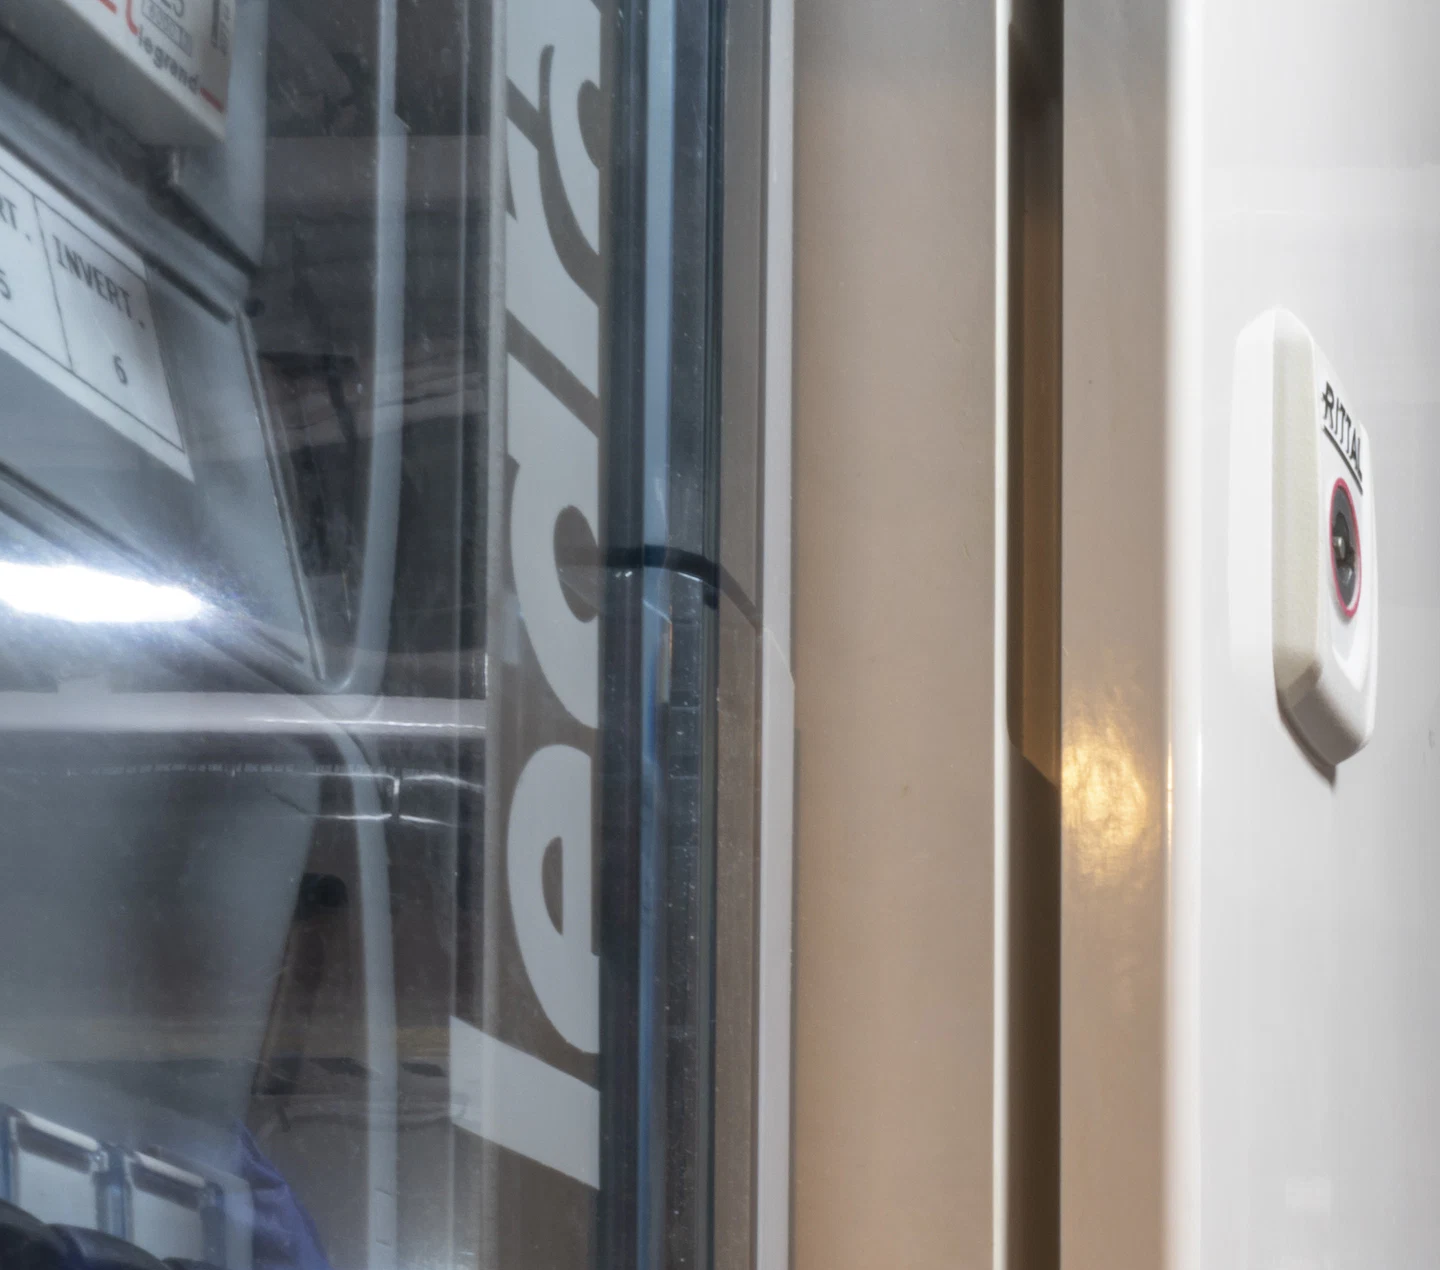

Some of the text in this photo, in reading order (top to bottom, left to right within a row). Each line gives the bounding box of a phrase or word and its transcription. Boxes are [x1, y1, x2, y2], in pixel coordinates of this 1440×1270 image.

[139, 24, 199, 94] legrand
[113, 354, 128, 385] 6
[1322, 381, 1362, 482] RITTAL
